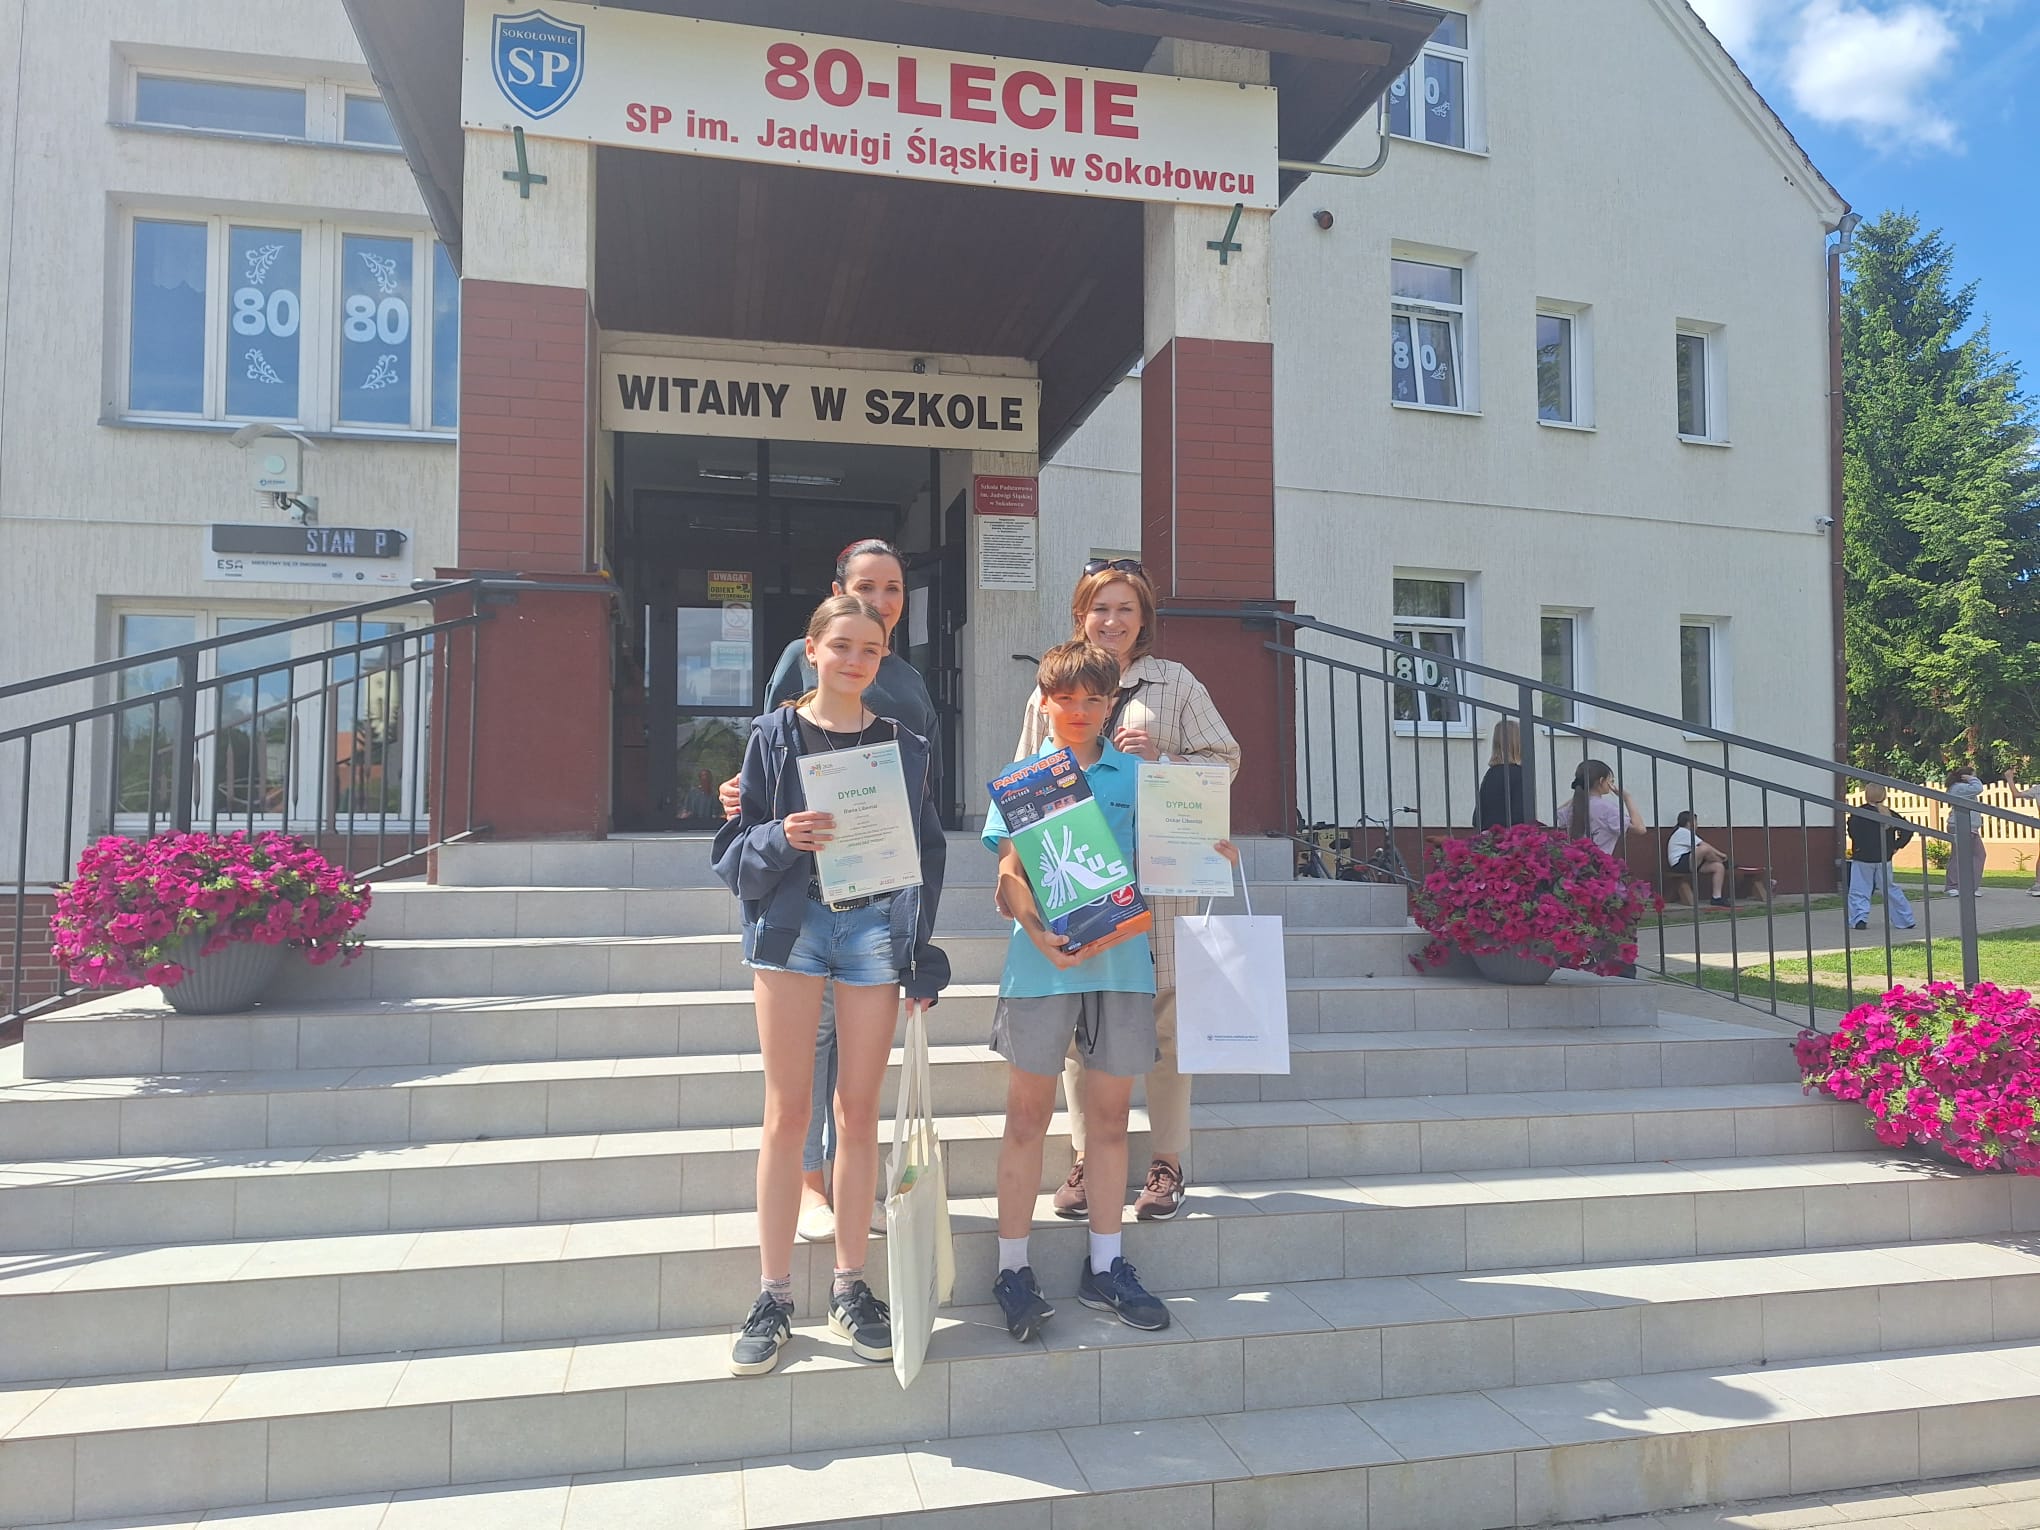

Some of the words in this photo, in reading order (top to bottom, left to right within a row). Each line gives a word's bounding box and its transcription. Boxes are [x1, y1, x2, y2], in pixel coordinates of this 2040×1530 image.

[502, 28, 576, 45] SOKOŁOWIEC
[508, 47, 570, 88] SP
[765, 42, 1139, 139] 80-LECIE
[626, 102, 672, 133] SP
[687, 109, 739, 143] im.
[757, 118, 891, 165] Jadwigi
[906, 127, 1038, 181] Śląskiej
[1050, 156, 1076, 177] w
[1085, 153, 1254, 194] Sokołowcu
[232, 287, 300, 337] 80
[344, 294, 410, 344] 80
[1393, 341, 1437, 371] 80
[617, 373, 790, 418] WITAMY
[810, 386, 847, 422] W
[865, 388, 1023, 431] SZKOLE
[306, 528, 355, 554] STAN
[713, 572, 747, 582] UWAGA!
[992, 750, 1068, 790] PARTYBOX
[1052, 760, 1071, 776] BT
[838, 786, 877, 800] DYPLOM
[1166, 801, 1203, 810] DYPLOM
